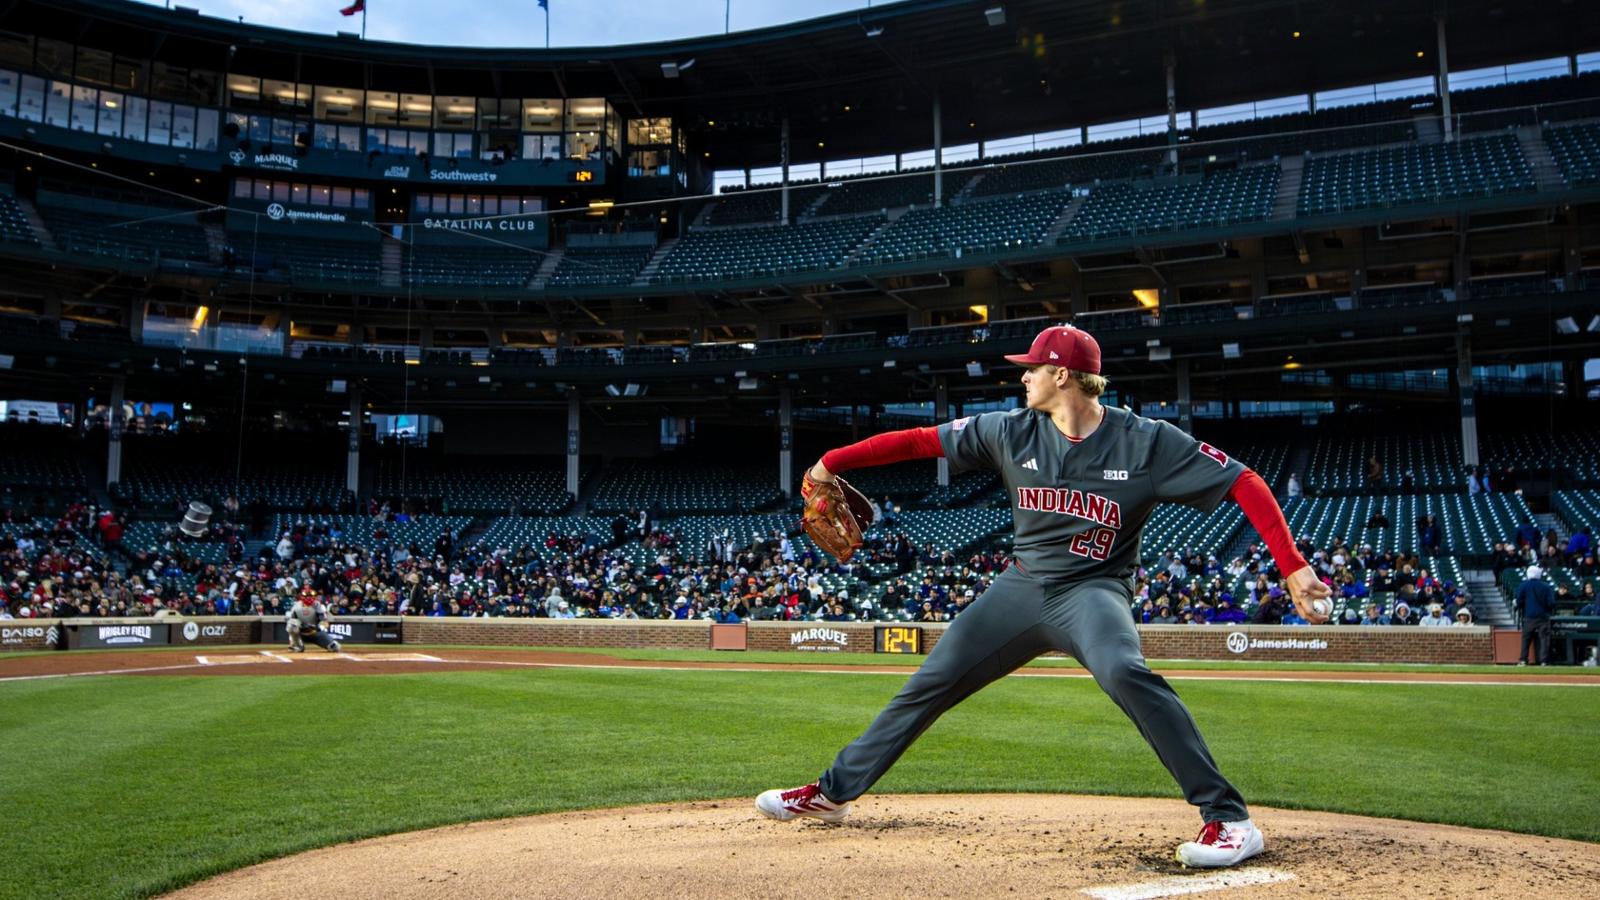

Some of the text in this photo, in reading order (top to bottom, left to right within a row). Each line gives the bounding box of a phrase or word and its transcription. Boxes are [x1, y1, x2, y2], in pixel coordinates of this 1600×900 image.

[254, 153, 298, 169] MARQUEE
[430, 169, 490, 181] Southwest
[286, 209, 346, 222] JamesHardie
[423, 218, 535, 231] CATALINA CLUB
[1018, 487, 1121, 529] INDIANA
[1069, 528, 1116, 561] 29
[2, 627, 44, 638] DAISO
[99, 625, 152, 640] WRIGLEY FIELD
[202, 625, 226, 636] razr
[330, 624, 352, 637] FIELD
[791, 628, 848, 645] MARQUEE
[1249, 638, 1328, 649] JamesHardie
